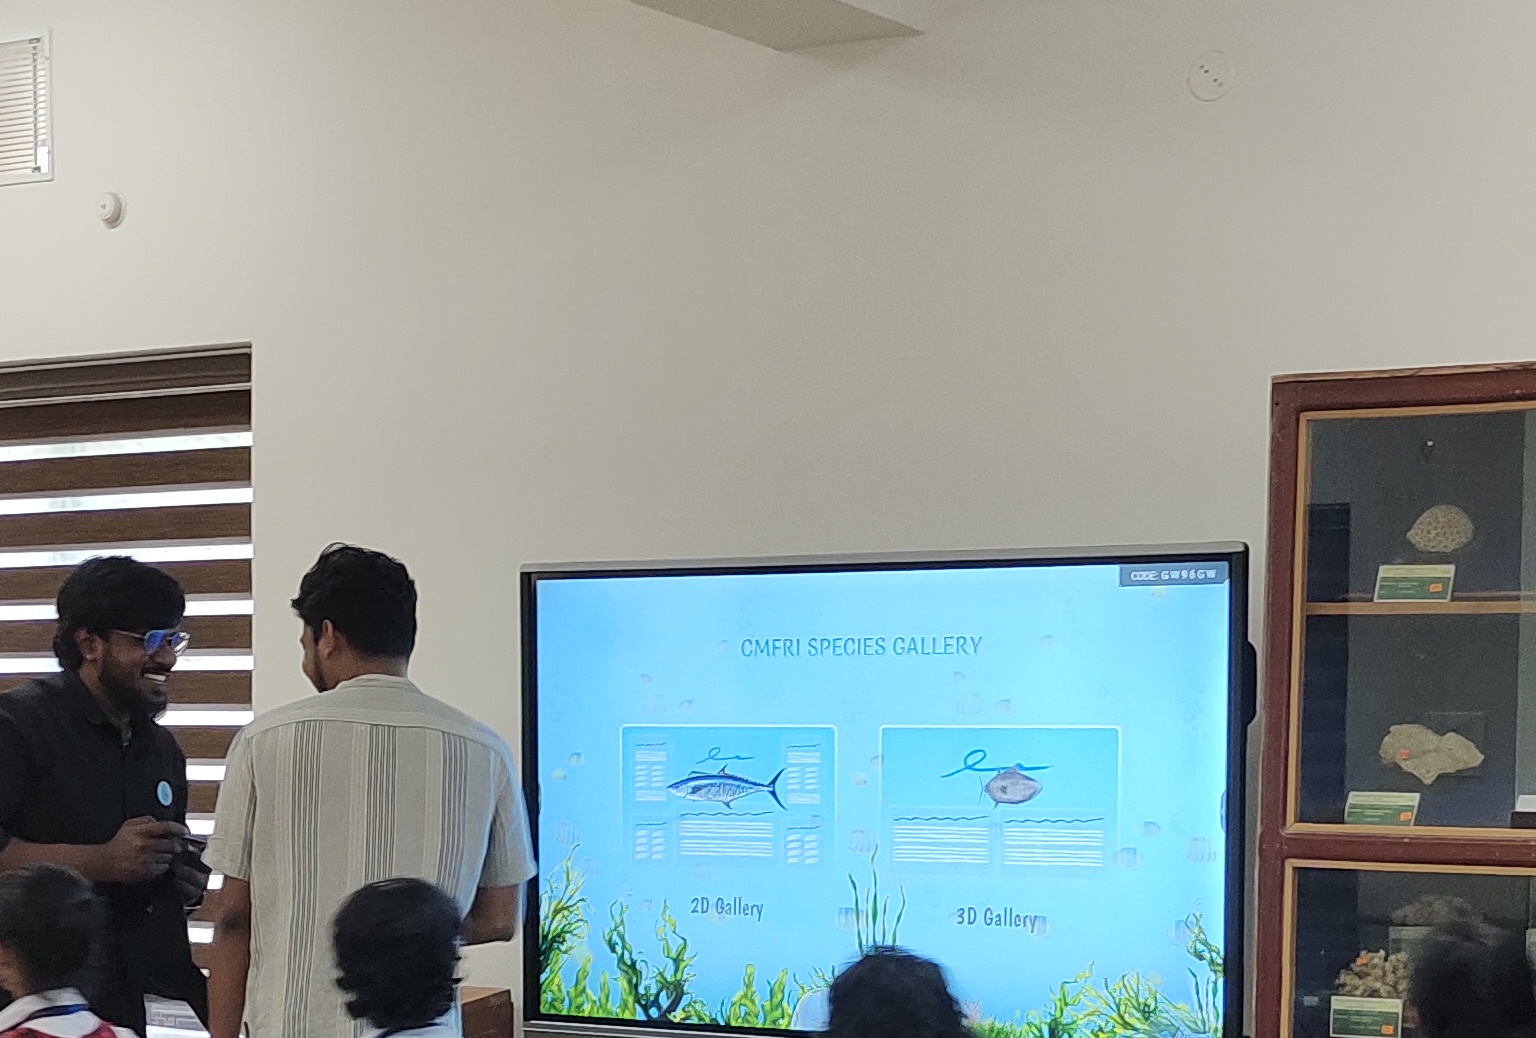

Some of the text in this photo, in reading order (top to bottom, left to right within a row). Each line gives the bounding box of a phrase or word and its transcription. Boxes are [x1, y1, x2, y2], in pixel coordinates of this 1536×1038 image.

[741, 635, 983, 657] CMFRI SPECIES GALLERY
[690, 896, 764, 922] 2D Gallery
[956, 906, 1038, 934] 3D Gallery
